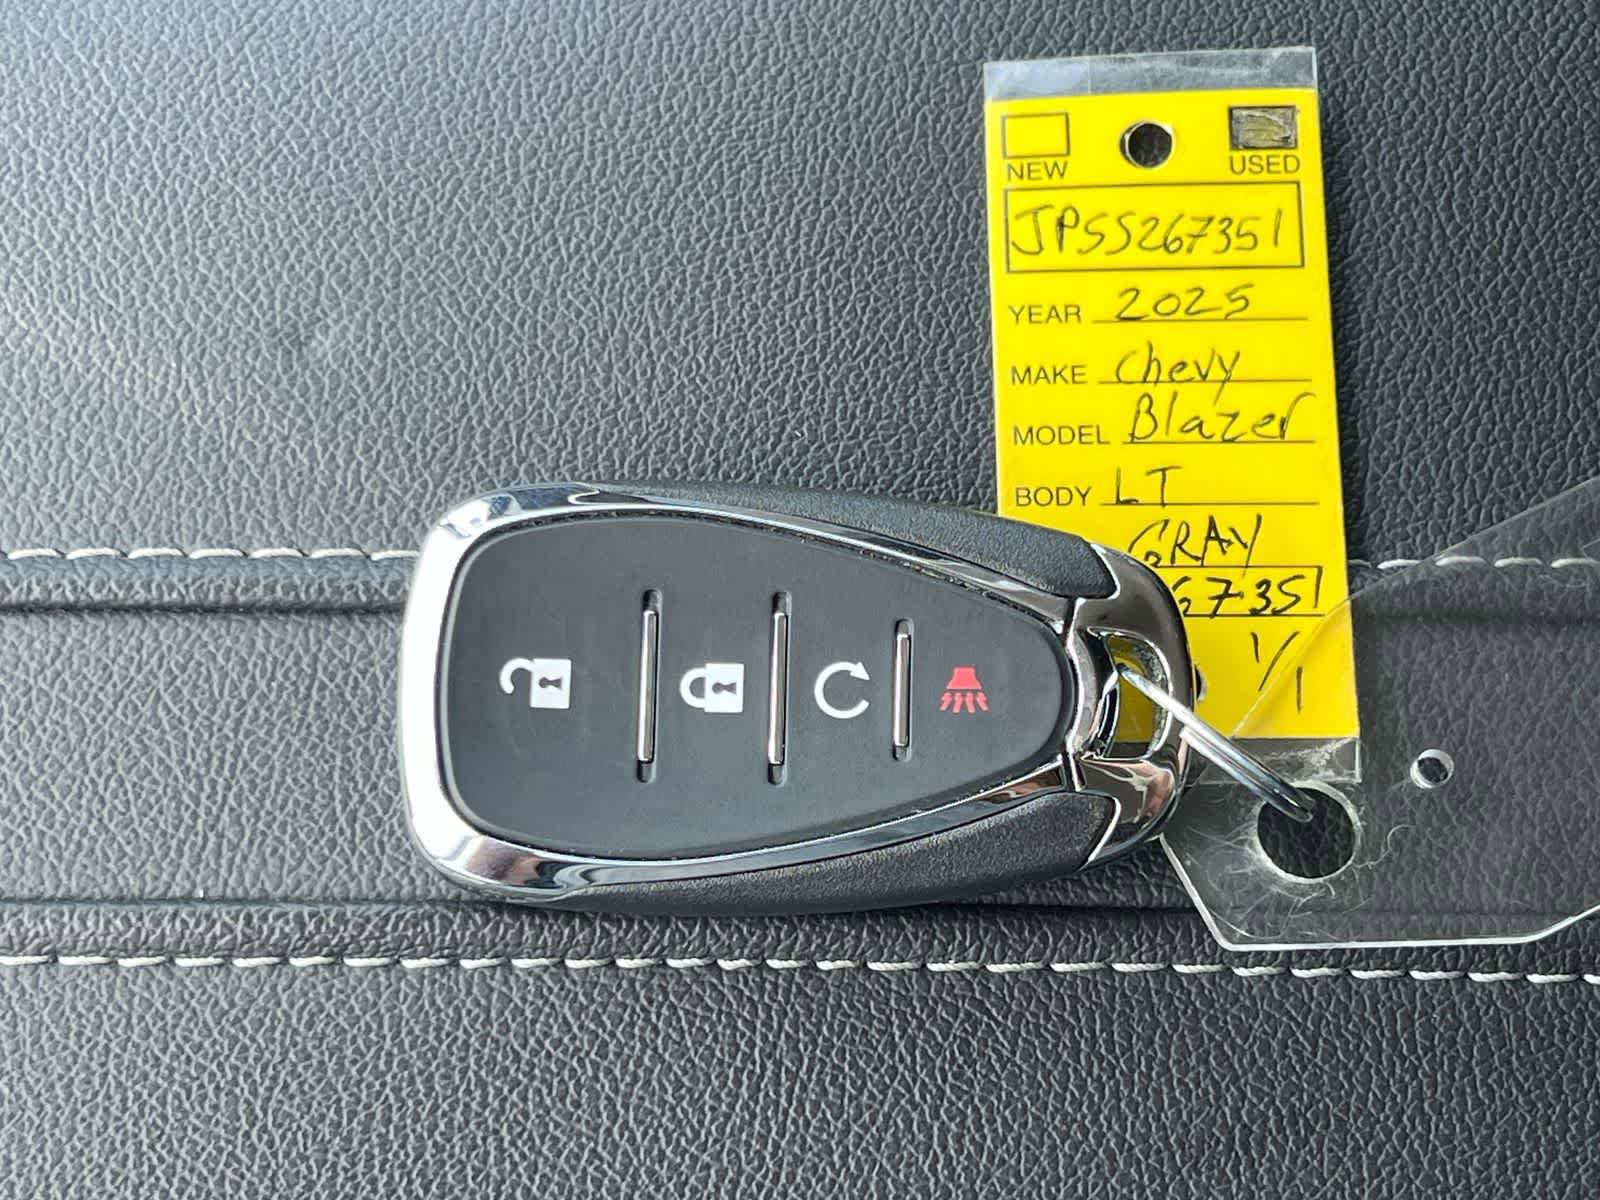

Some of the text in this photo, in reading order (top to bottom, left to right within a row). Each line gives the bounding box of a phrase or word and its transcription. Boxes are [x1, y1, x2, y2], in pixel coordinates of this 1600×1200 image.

[1007, 161, 1069, 181] NEW
[1229, 154, 1301, 175] USED
[1008, 284, 1255, 325] YEAR 2025
[1011, 341, 1241, 405] MAKE Chevy
[1013, 391, 1317, 445] MODEL Blazer
[1015, 465, 1184, 508] BODY LT
[1127, 513, 1263, 577] GRAY
